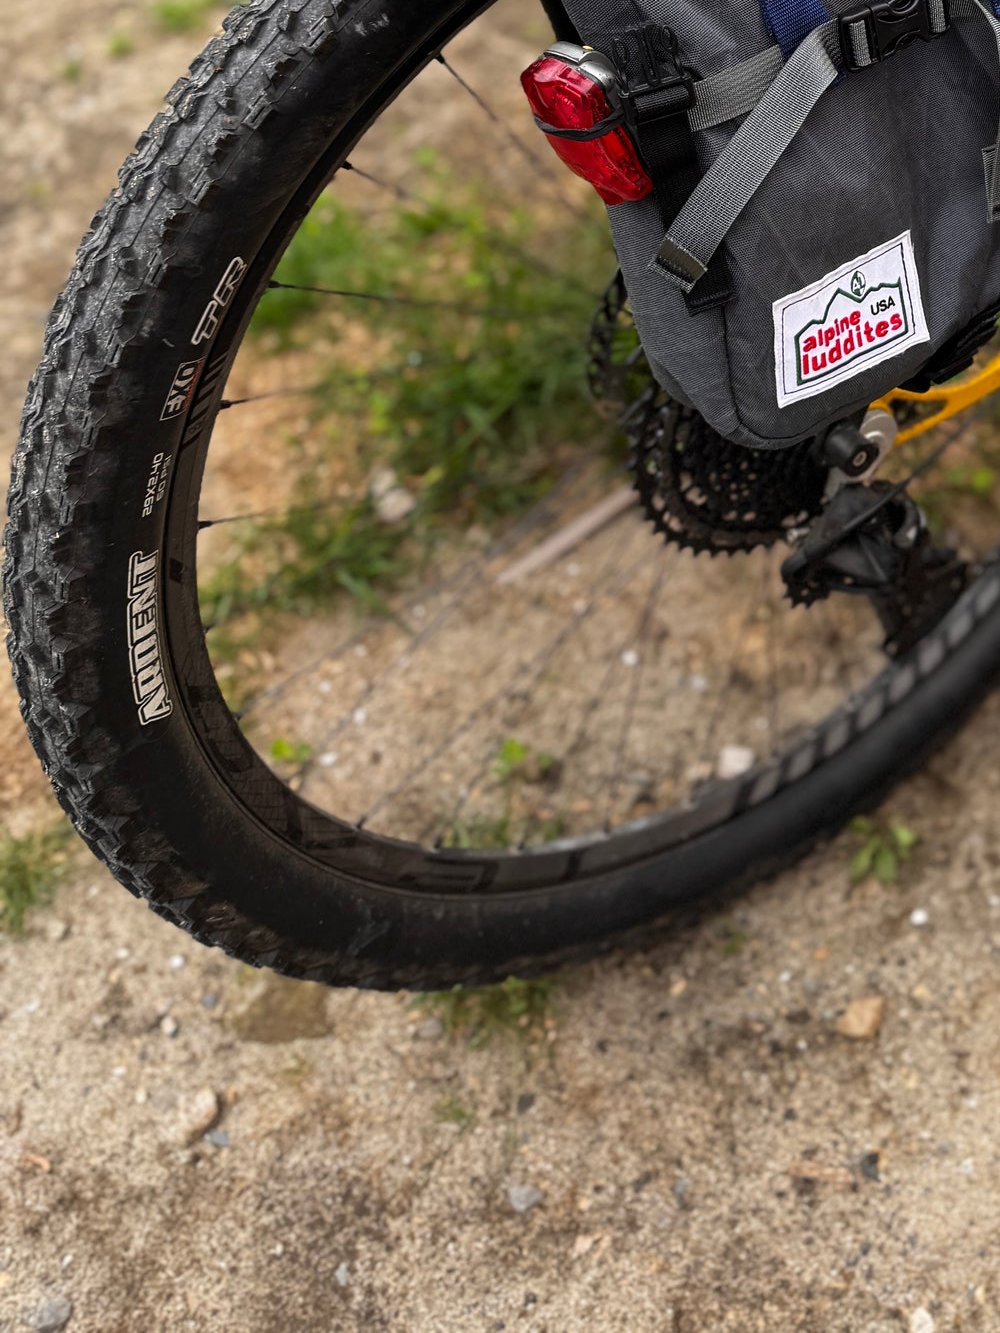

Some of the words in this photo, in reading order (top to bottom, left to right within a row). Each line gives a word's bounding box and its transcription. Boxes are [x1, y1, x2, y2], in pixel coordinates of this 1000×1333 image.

[191, 256, 248, 345] TR
[802, 310, 861, 353] alpine
[871, 296, 897, 316] USA
[802, 313, 903, 375] luddites
[127, 550, 173, 726] ARDENT
